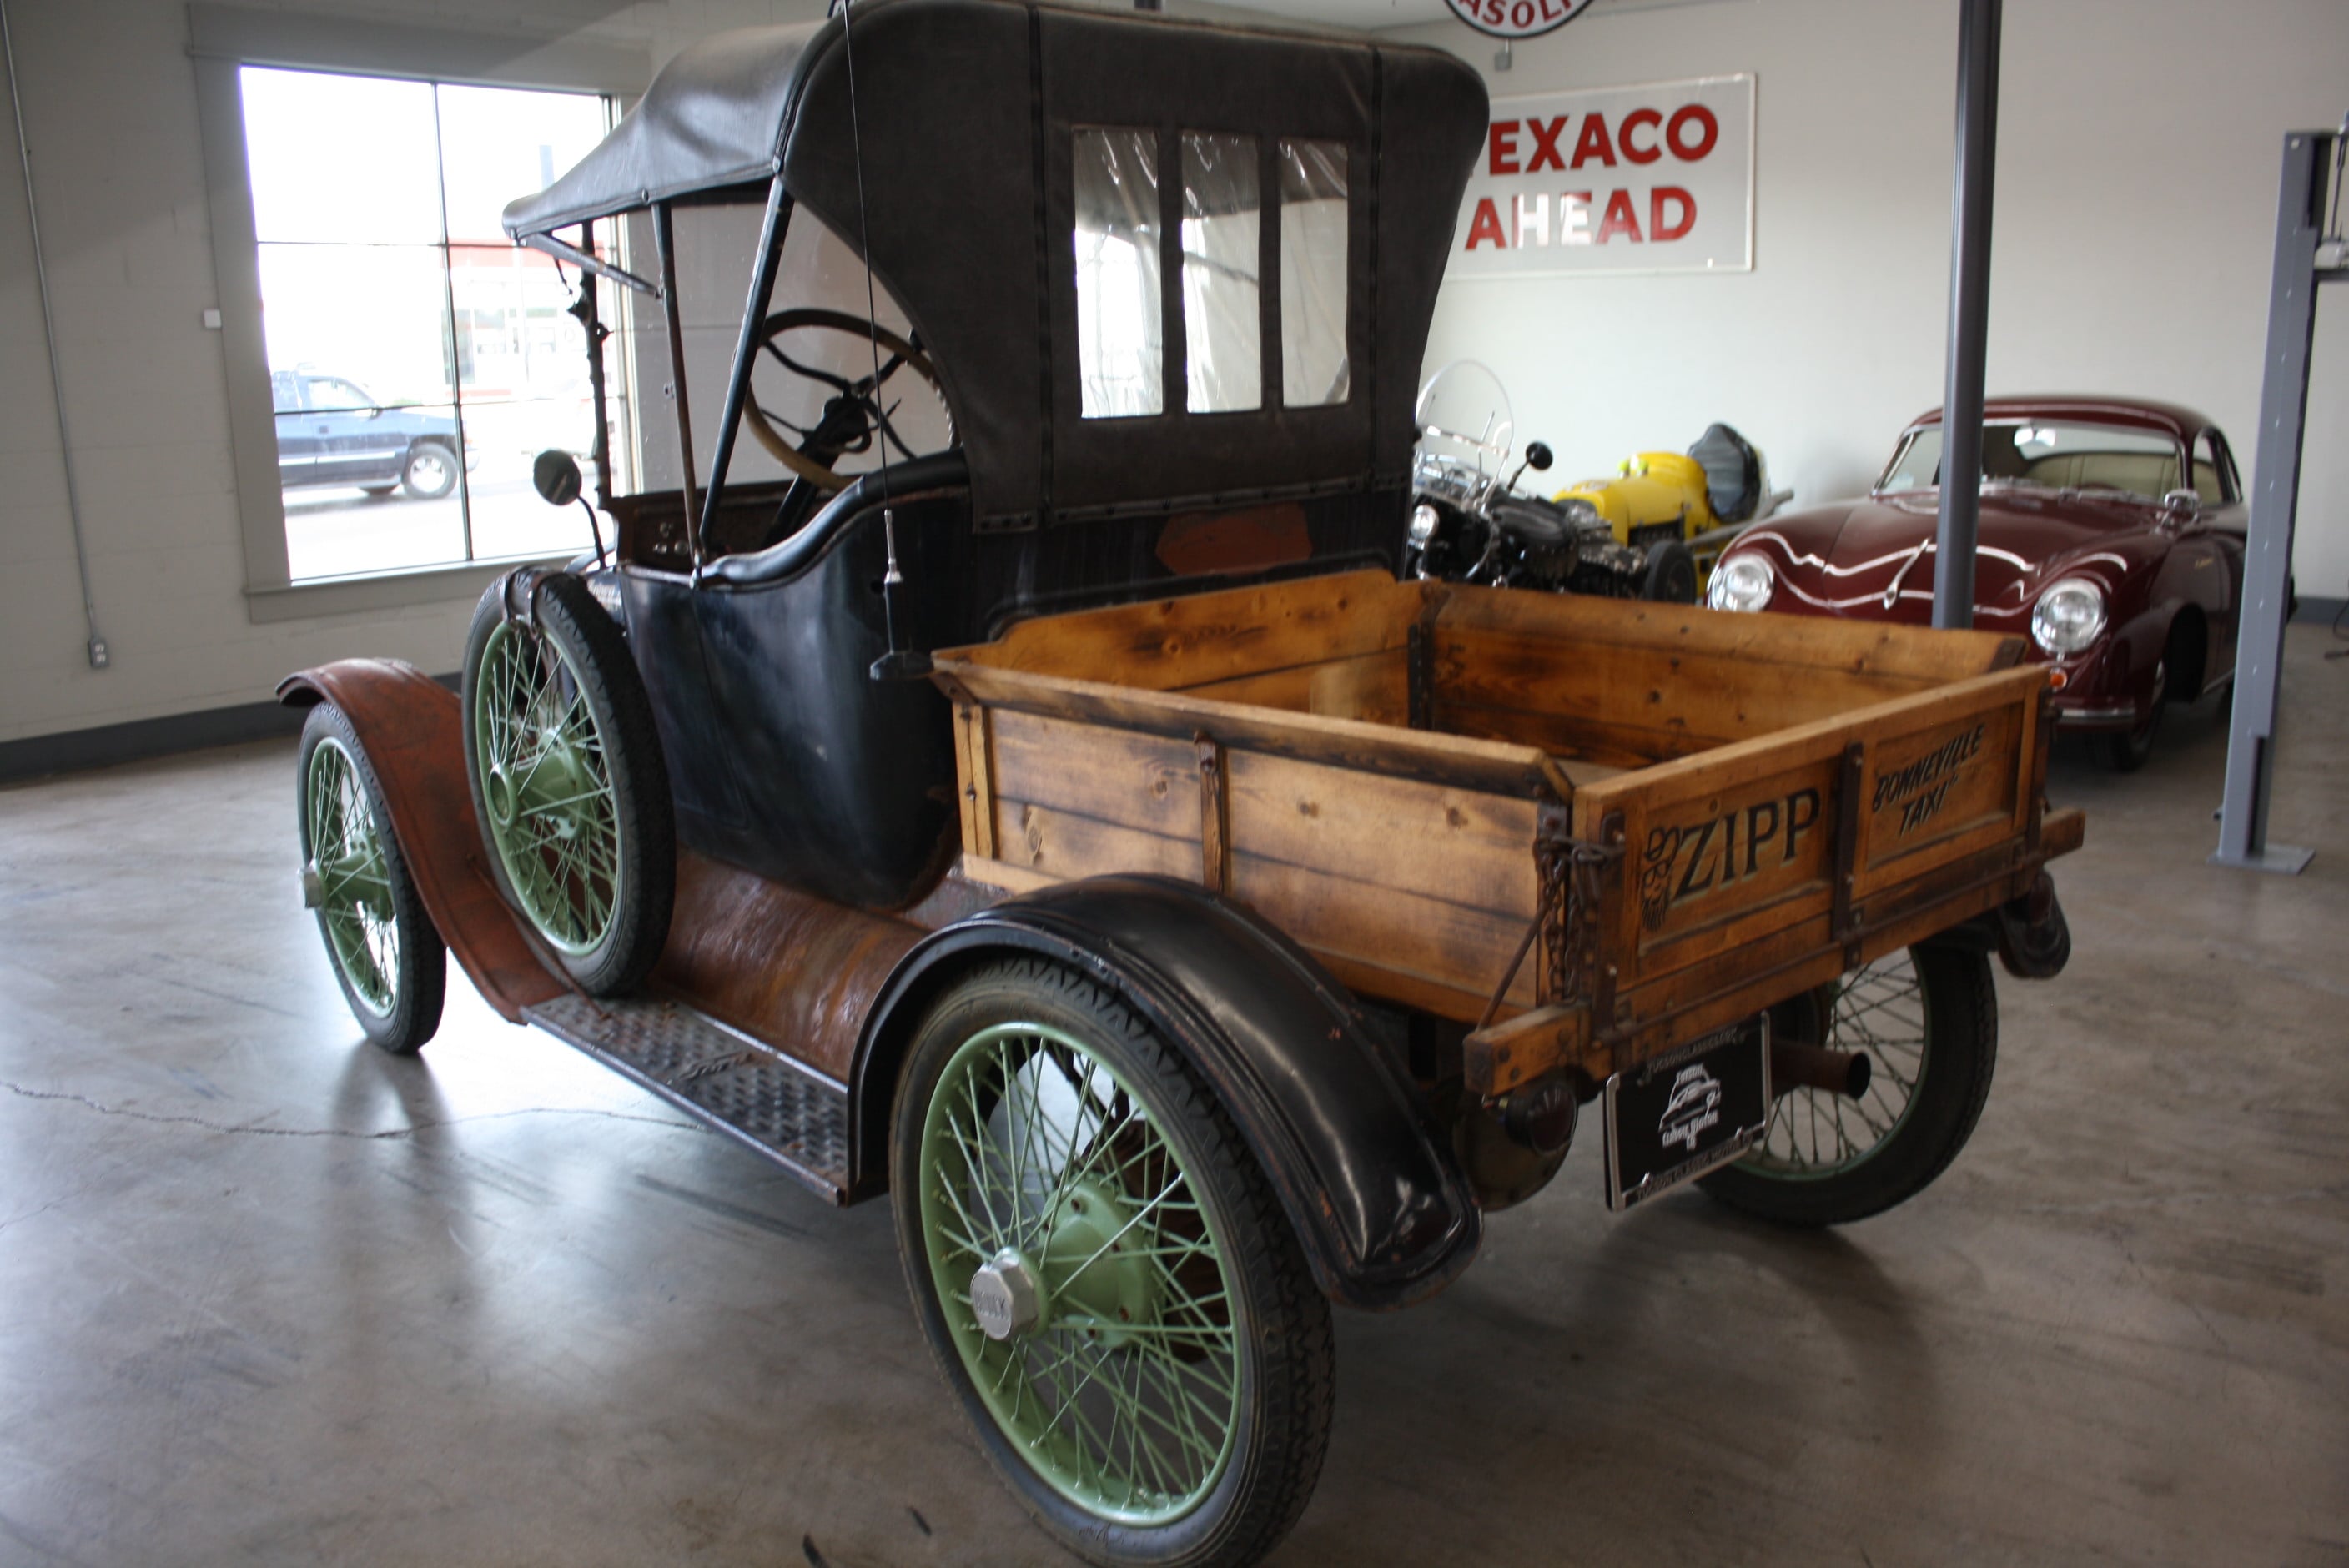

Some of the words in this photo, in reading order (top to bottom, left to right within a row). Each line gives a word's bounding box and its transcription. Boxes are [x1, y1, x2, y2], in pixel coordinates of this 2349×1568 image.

[1471, 103, 1718, 176] EXACO
[1465, 186, 1697, 251] AHEAD
[1674, 787, 1820, 902] ZIPP
